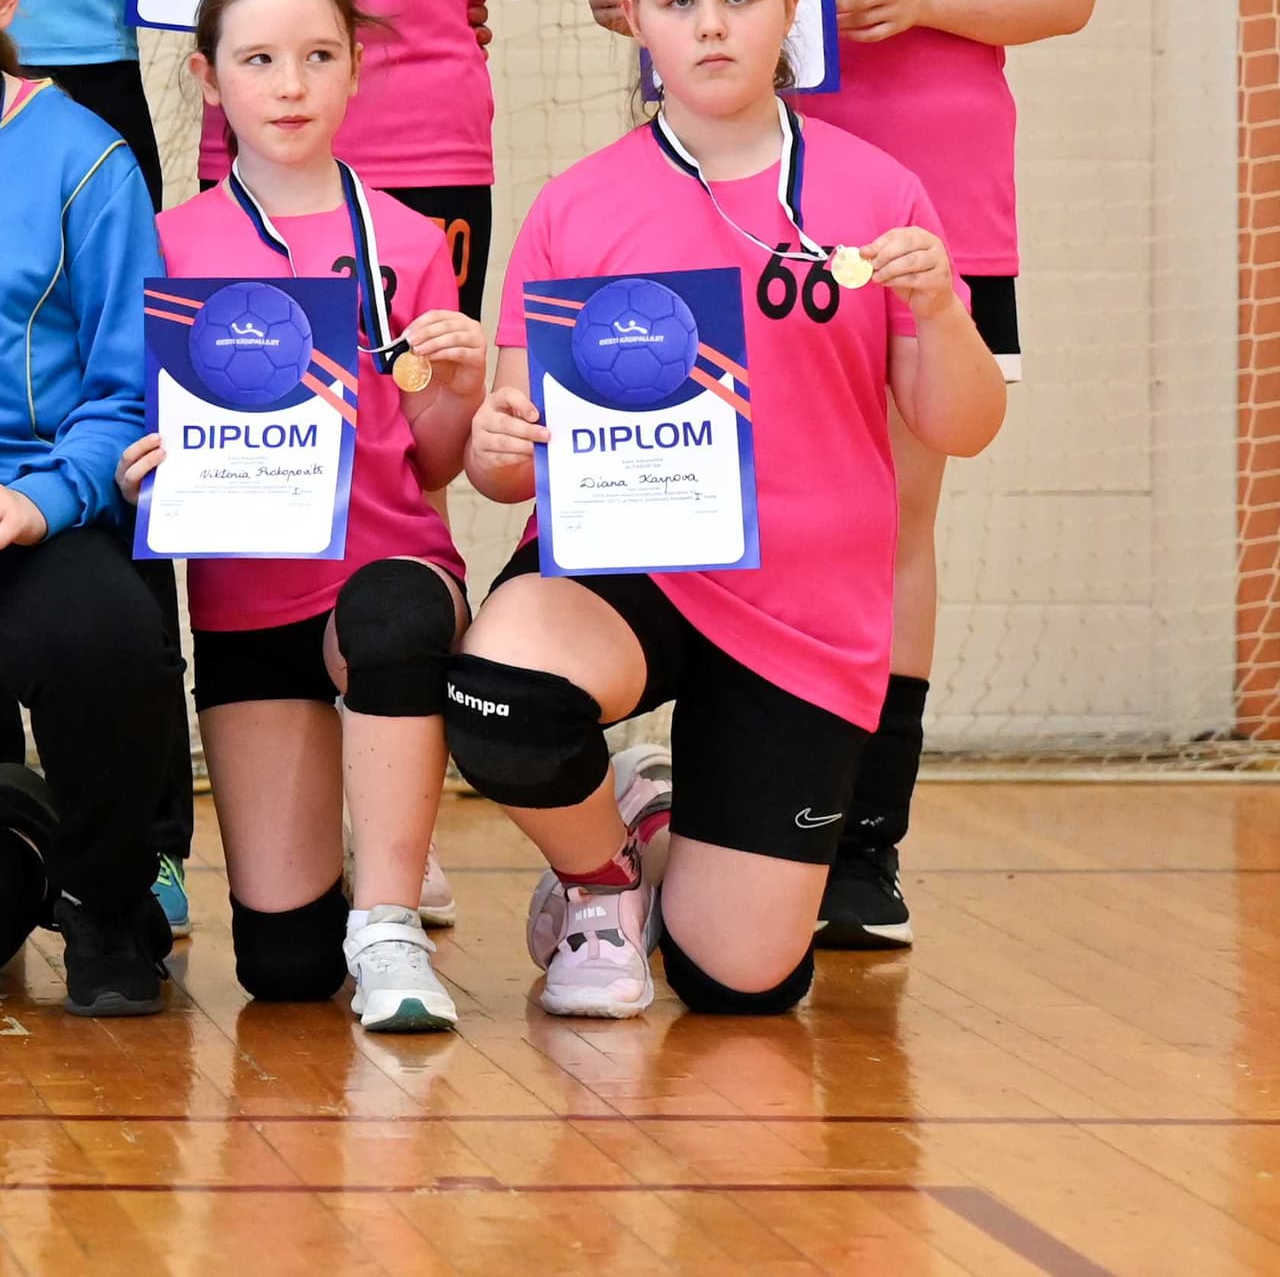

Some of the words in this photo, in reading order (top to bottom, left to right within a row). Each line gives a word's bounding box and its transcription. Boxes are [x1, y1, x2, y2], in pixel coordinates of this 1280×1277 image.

[756, 242, 840, 324] 66
[183, 424, 318, 450] DIPLOM
[571, 420, 713, 454] DIPLOM
[580, 477, 628, 489] Diana
[447, 681, 510, 717] Kempa
